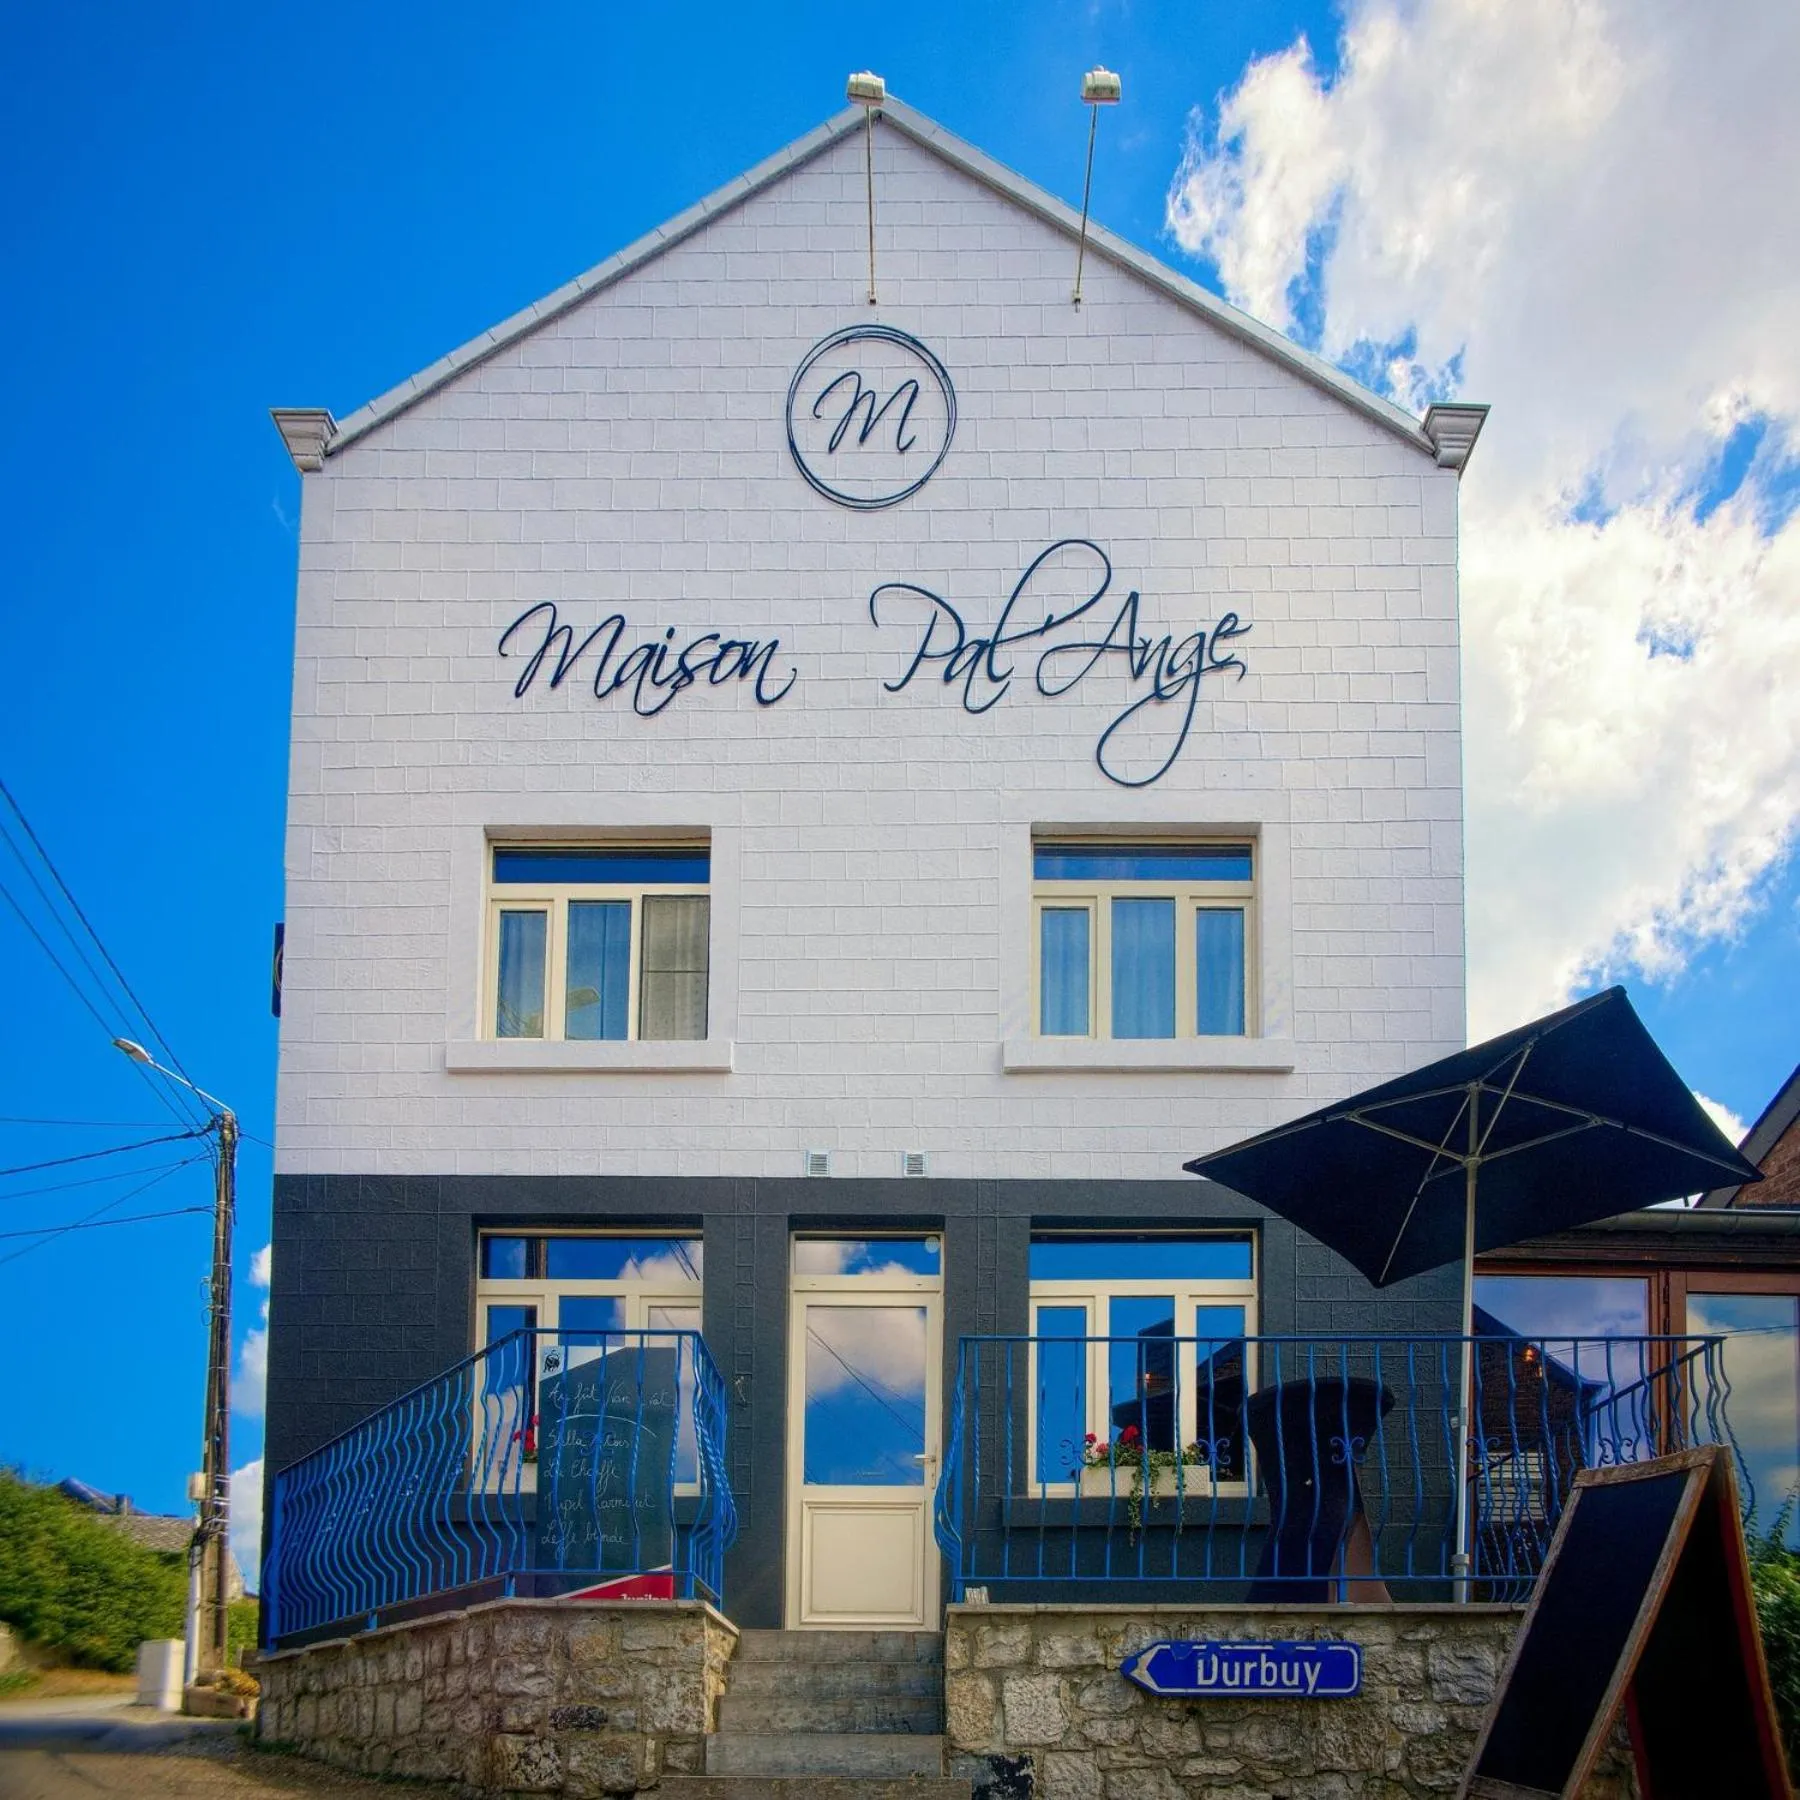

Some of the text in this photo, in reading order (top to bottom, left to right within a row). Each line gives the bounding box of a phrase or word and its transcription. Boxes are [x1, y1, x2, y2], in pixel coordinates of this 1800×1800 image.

[812, 370, 920, 455] M
[497, 601, 798, 717] Maison
[1196, 1653, 1322, 1695] Durbuy
